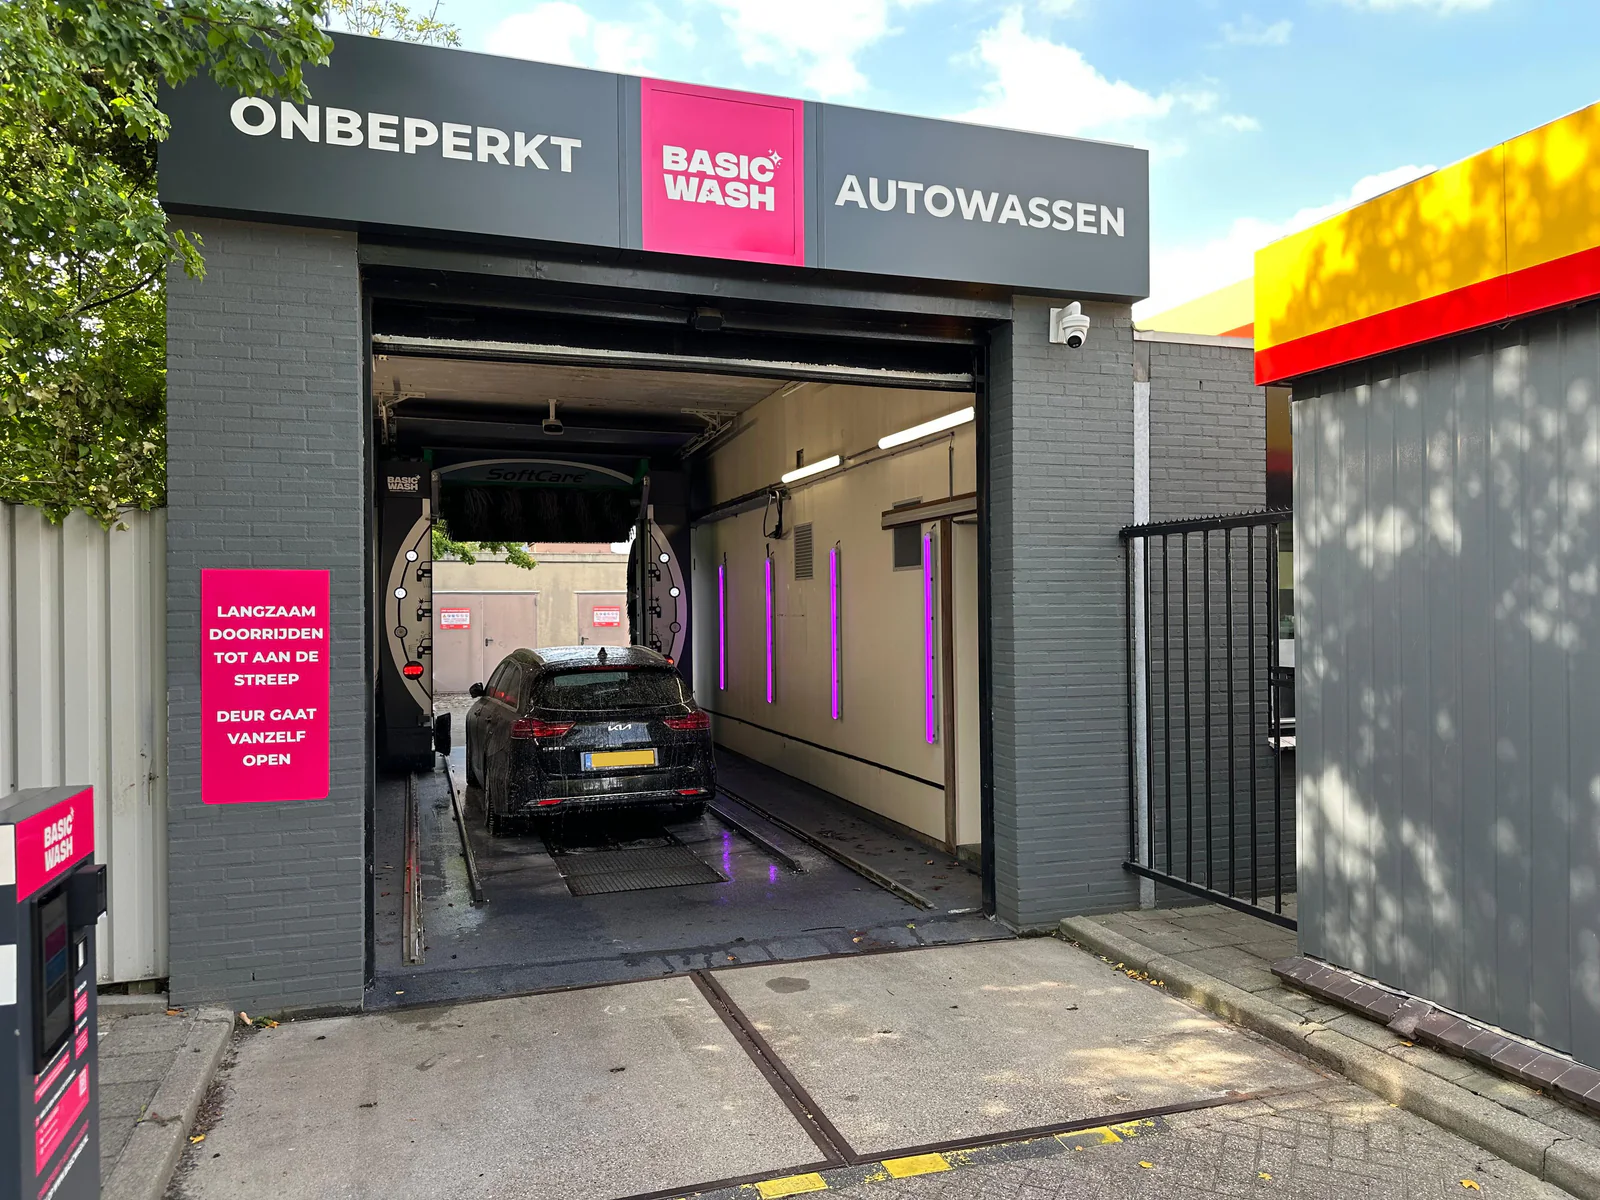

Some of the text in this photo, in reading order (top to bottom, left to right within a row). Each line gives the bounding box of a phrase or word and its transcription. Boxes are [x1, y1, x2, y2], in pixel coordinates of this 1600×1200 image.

[230, 97, 582, 173] ONBEPERKT
[662, 145, 775, 183] BASIC
[663, 173, 775, 212] WASH
[834, 174, 1125, 238] AUTOWASSEN
[387, 476, 418, 484] BASIC
[388, 483, 418, 491] WASH
[217, 605, 316, 618] LANGZAAM
[209, 628, 324, 640] DOORRIJDEN
[214, 650, 319, 664] TOT AAN DE
[234, 673, 300, 686] STREEP
[216, 708, 317, 723] DEUR GAAT
[227, 730, 307, 745] VANZELF
[242, 753, 291, 766] OPEN
[44, 814, 73, 849] BASIC
[44, 835, 73, 872] WASH
